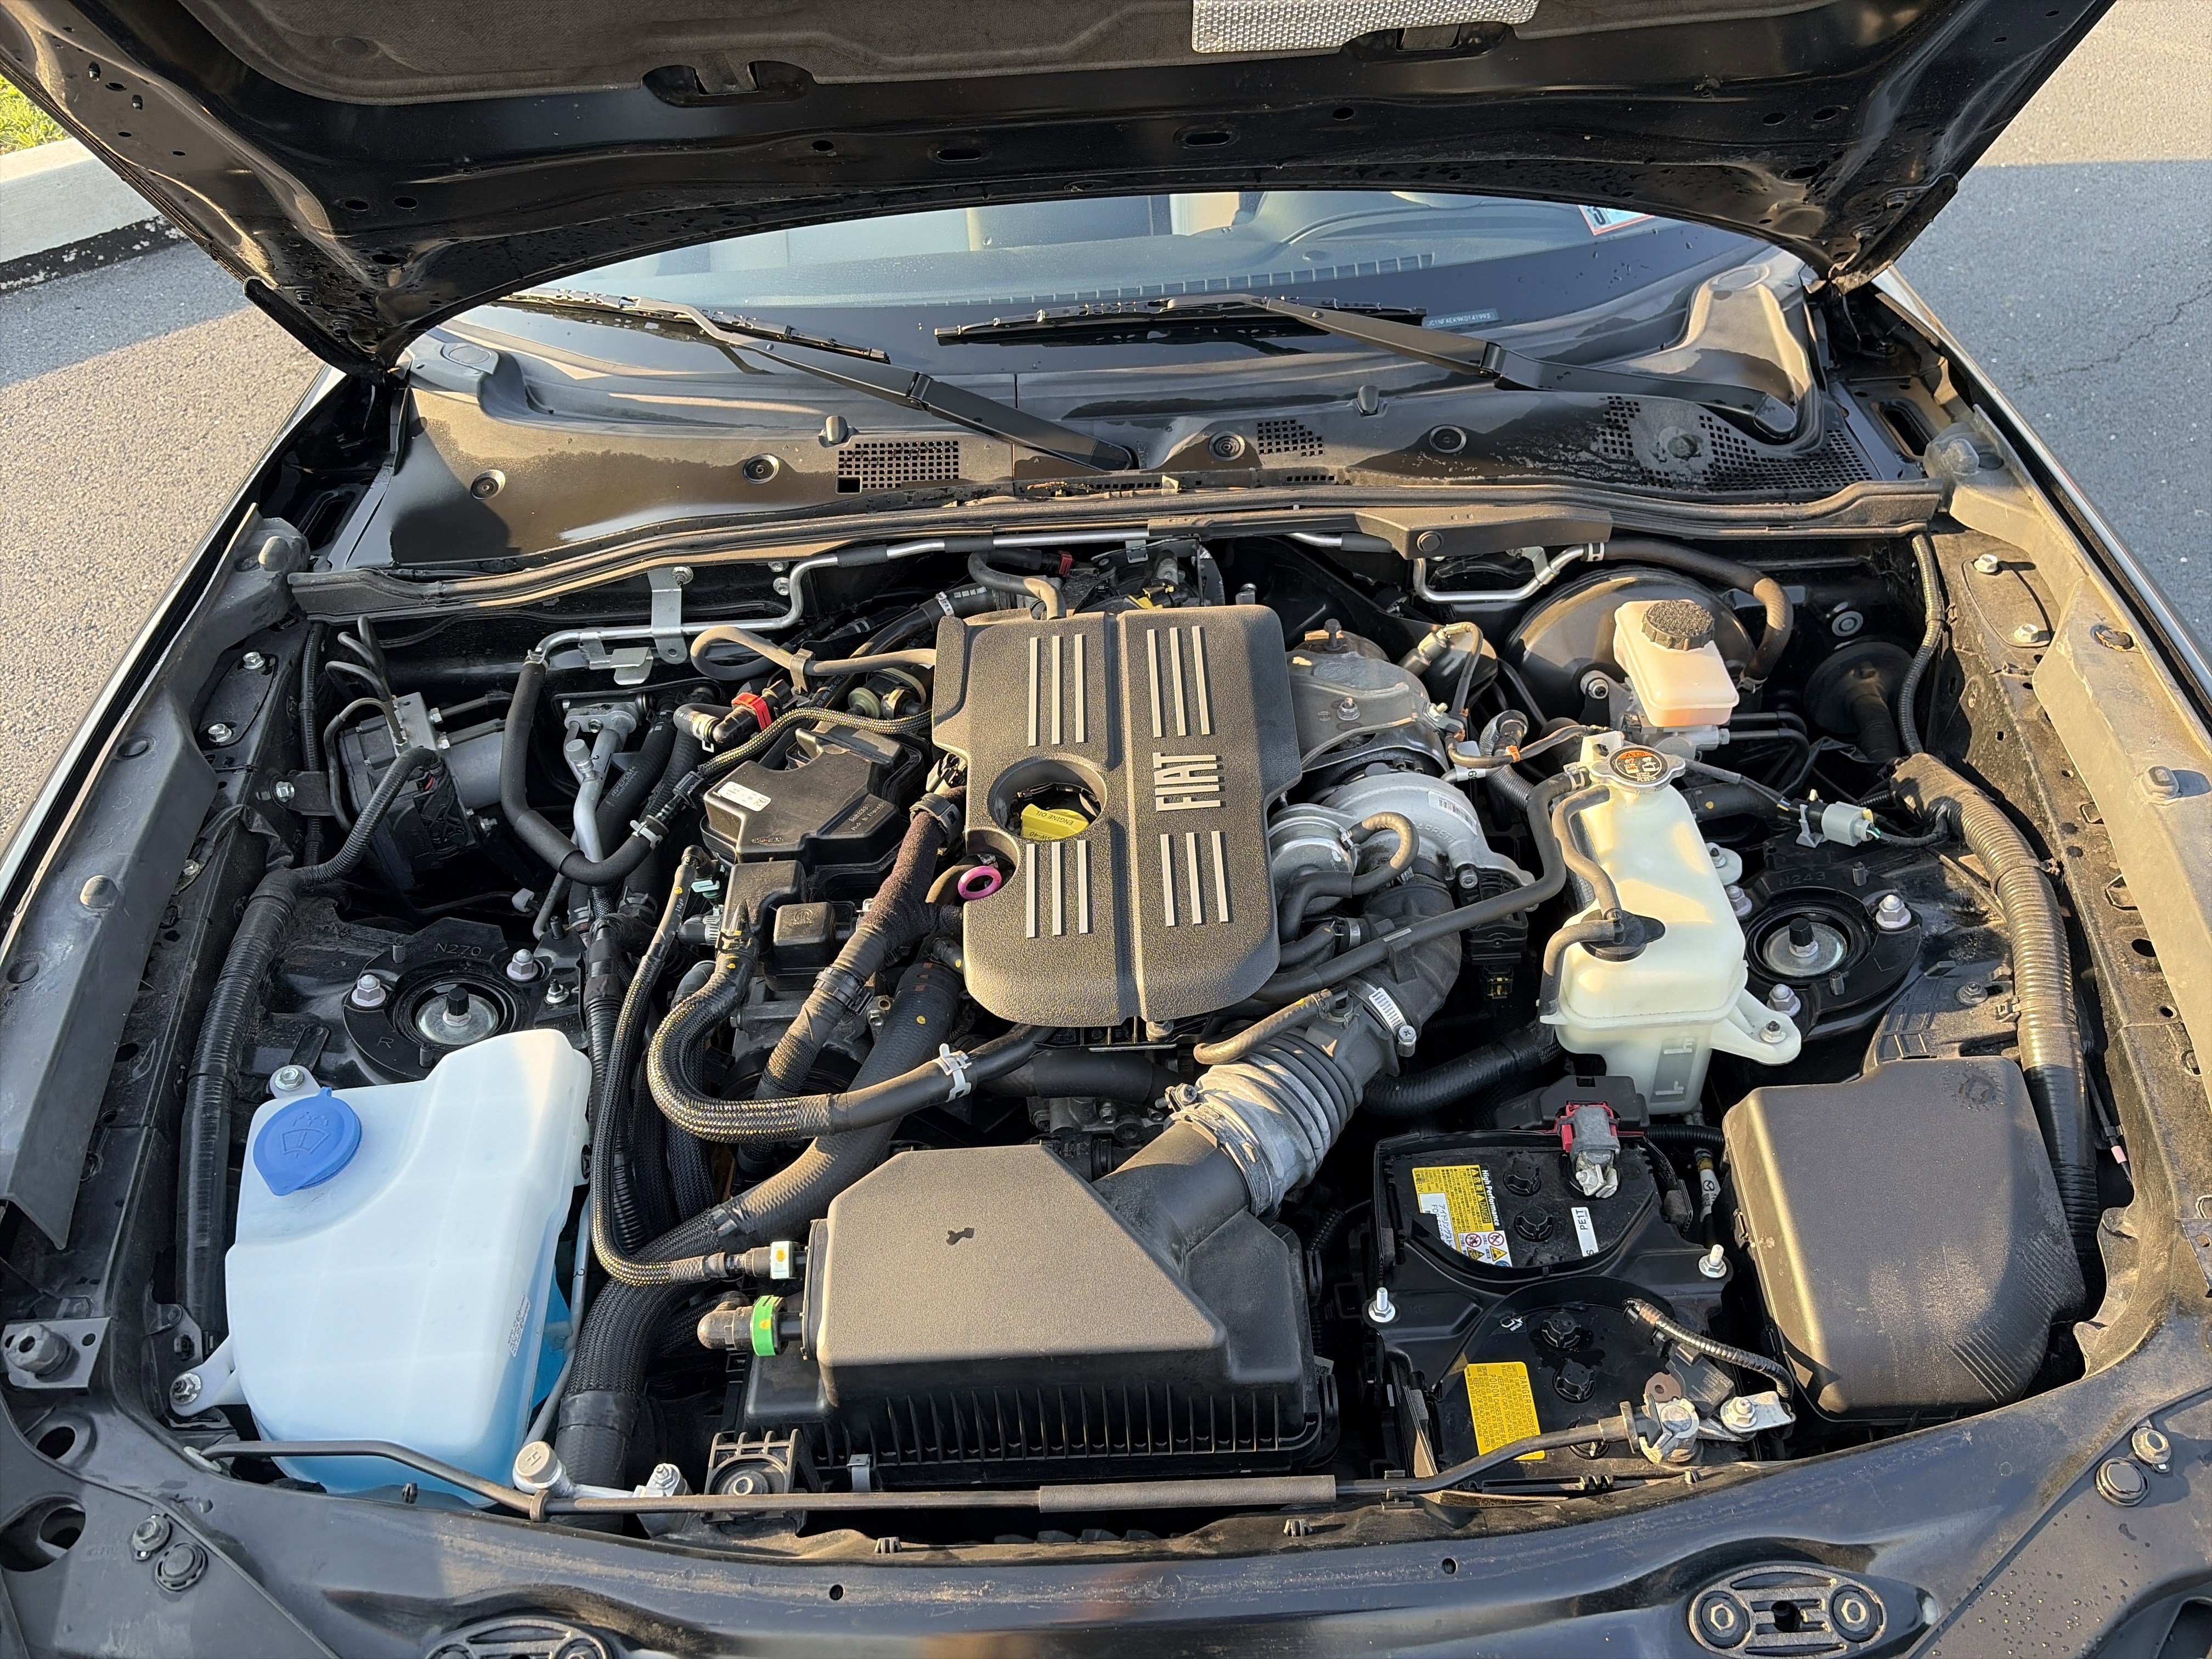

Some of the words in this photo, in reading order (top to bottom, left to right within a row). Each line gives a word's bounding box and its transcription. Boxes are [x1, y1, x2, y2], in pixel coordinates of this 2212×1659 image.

[1153, 752, 1221, 812] FIAT
[1047, 814, 1074, 826] ENGINE
[435, 943, 482, 957] N270
[1480, 1170, 1491, 1184] High
[1479, 1201, 1489, 1222] DANGER
[1485, 1186, 1500, 1226] Performance
[1488, 1374, 1500, 1398] POISON
[1519, 1375, 1532, 1403] DANGER
